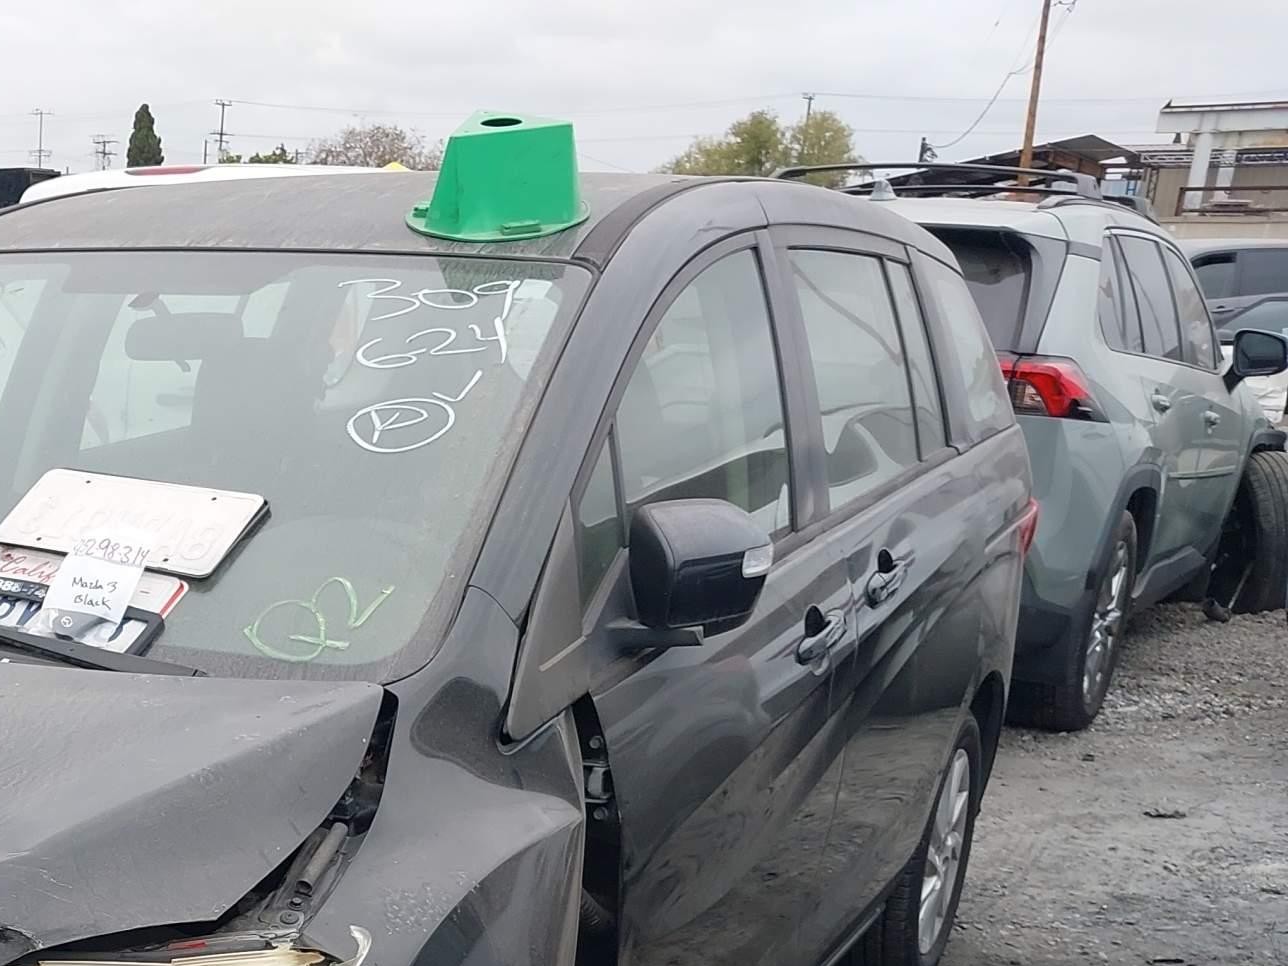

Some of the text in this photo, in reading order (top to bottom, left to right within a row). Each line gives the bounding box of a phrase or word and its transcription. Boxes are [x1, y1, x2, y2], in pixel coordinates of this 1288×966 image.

[337, 278, 521, 321] 309
[356, 316, 508, 369] 624
[0, 555, 57, 584] Calif
[73, 594, 112, 611] Black
